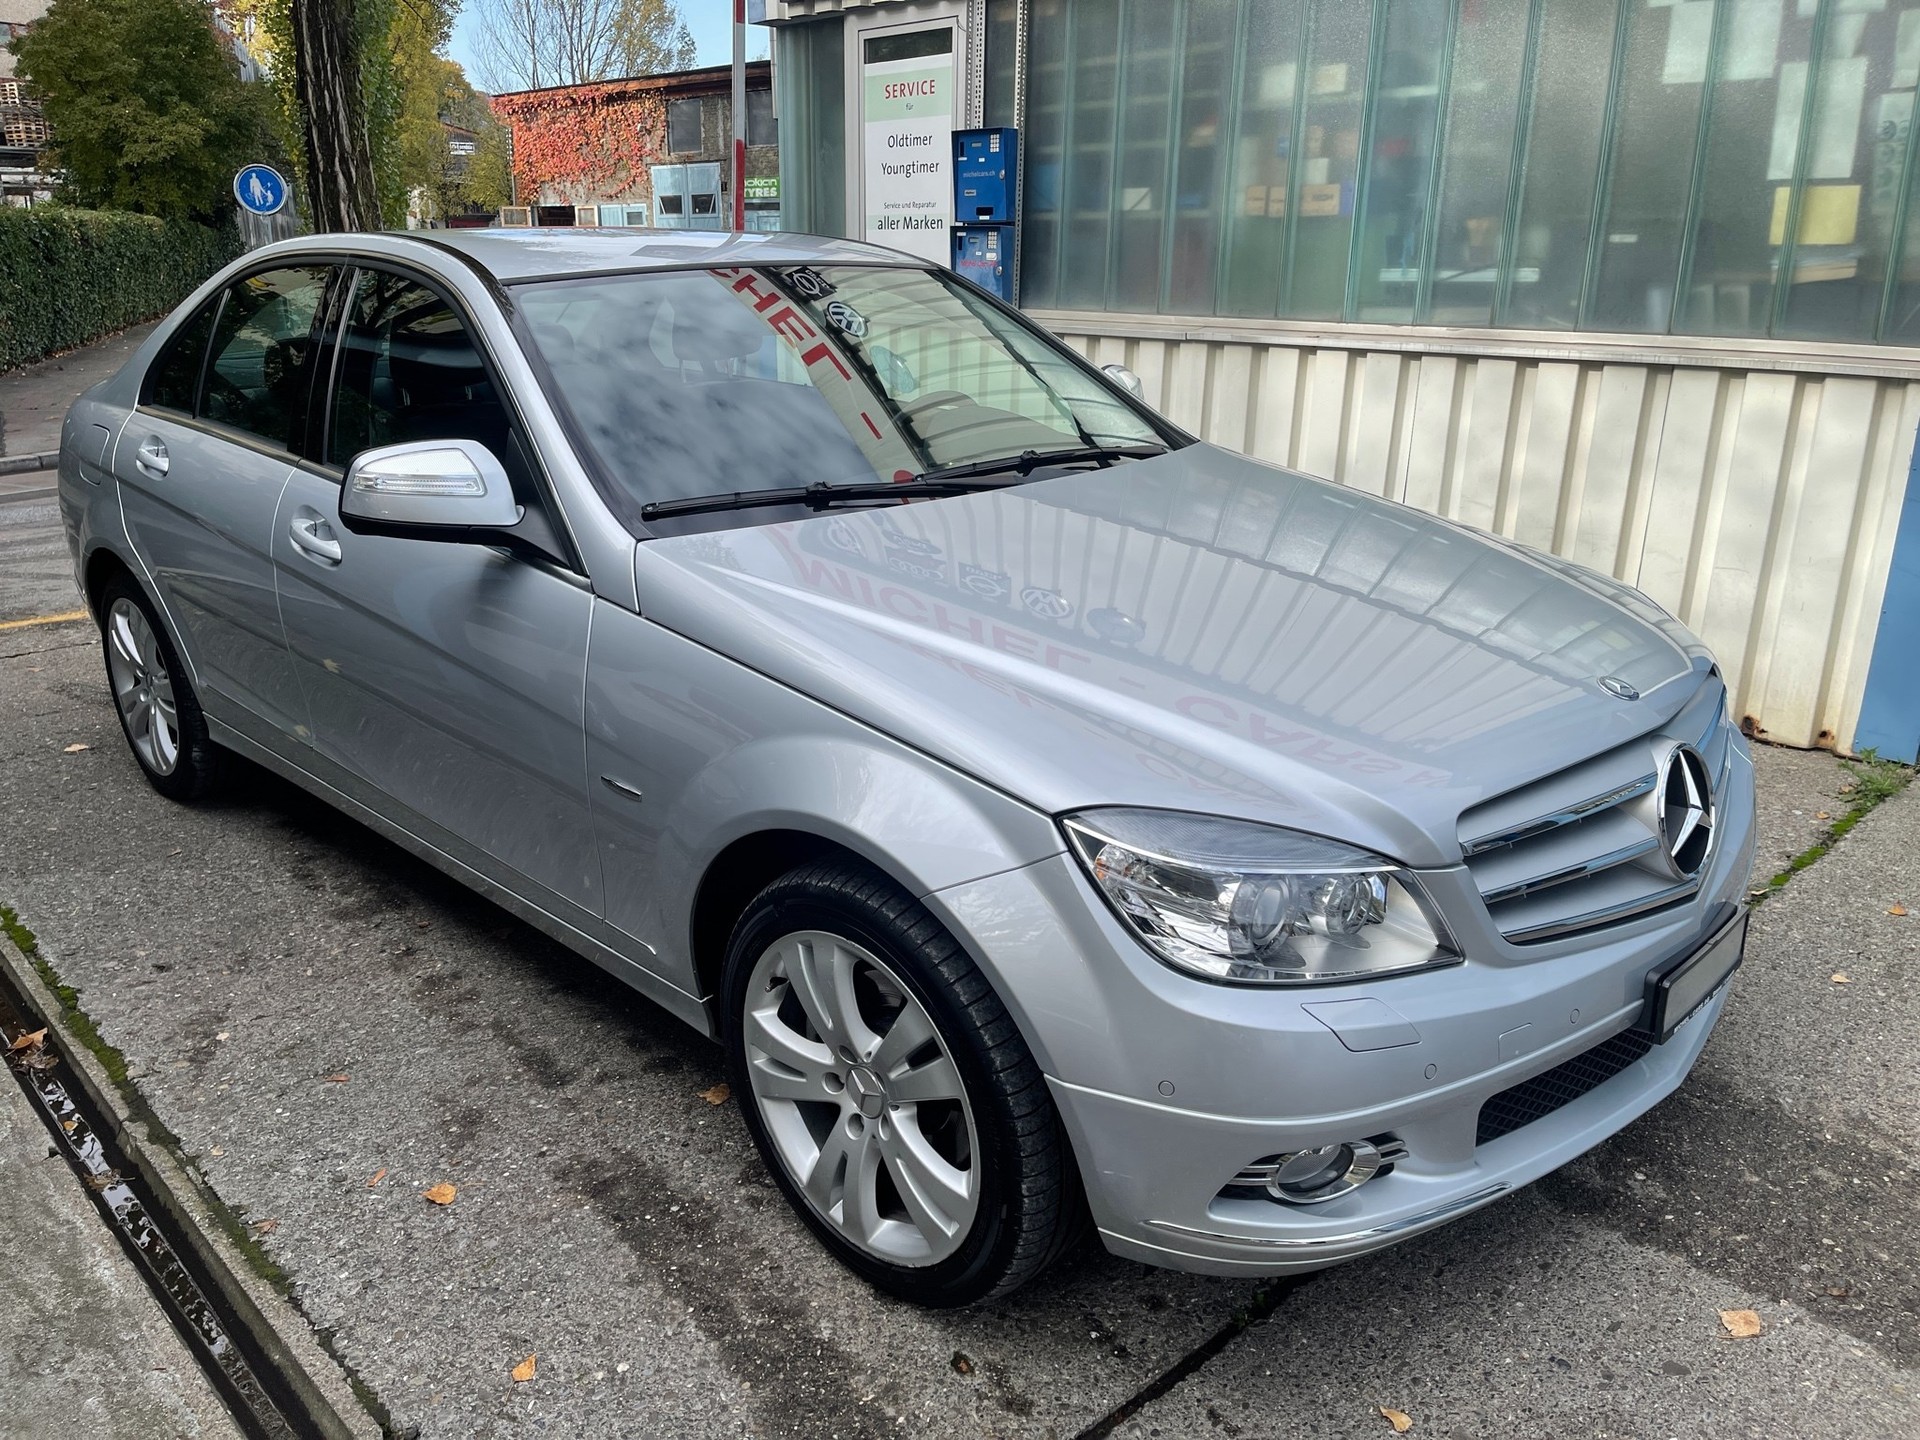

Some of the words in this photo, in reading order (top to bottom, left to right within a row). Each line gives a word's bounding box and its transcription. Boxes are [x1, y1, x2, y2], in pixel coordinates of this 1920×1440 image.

[885, 79, 936, 99] SERVICE
[887, 133, 933, 148] Oldtimer
[881, 160, 940, 178] Youngtimer
[877, 215, 900, 230] aller
[902, 214, 943, 230] Marken
